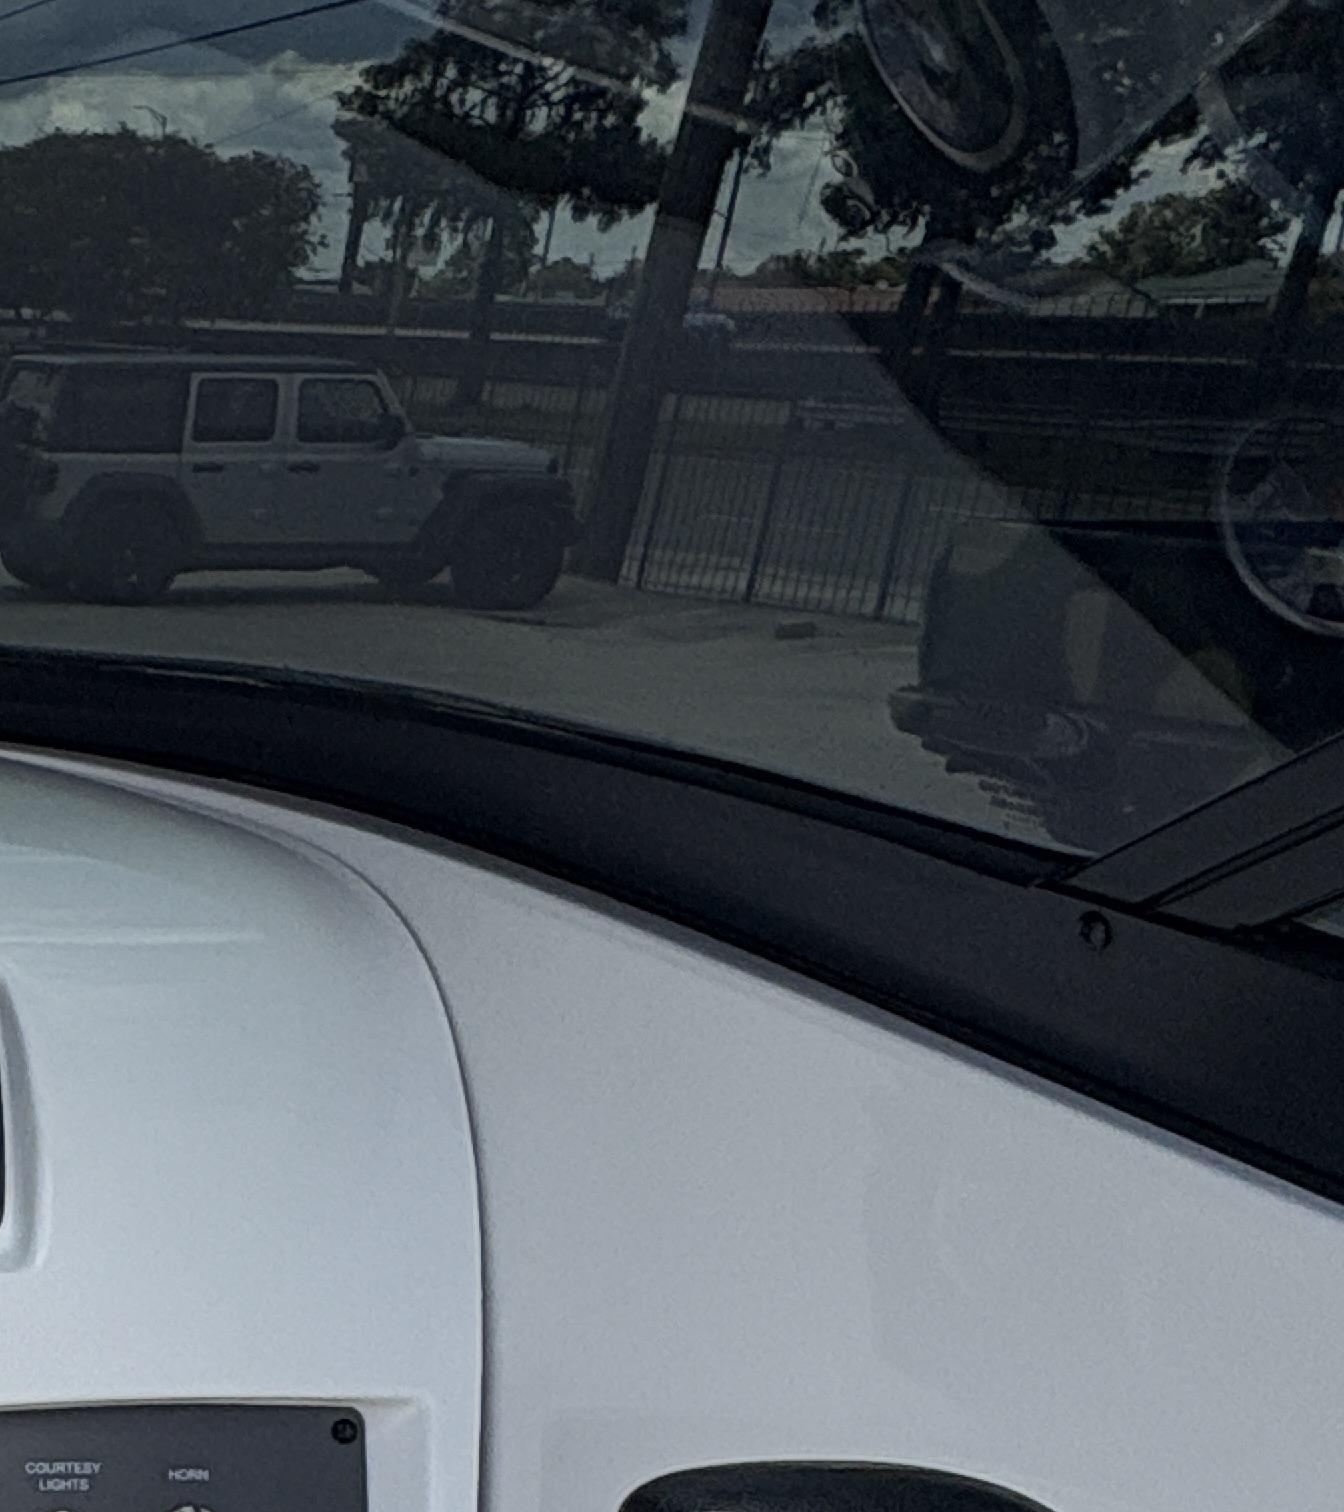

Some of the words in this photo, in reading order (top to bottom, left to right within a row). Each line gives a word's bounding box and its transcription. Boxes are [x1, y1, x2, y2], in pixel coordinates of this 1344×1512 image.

[24, 1462, 102, 1475] COURTESY
[168, 1468, 210, 1481] HORN
[38, 1478, 89, 1492] LIGHTS
